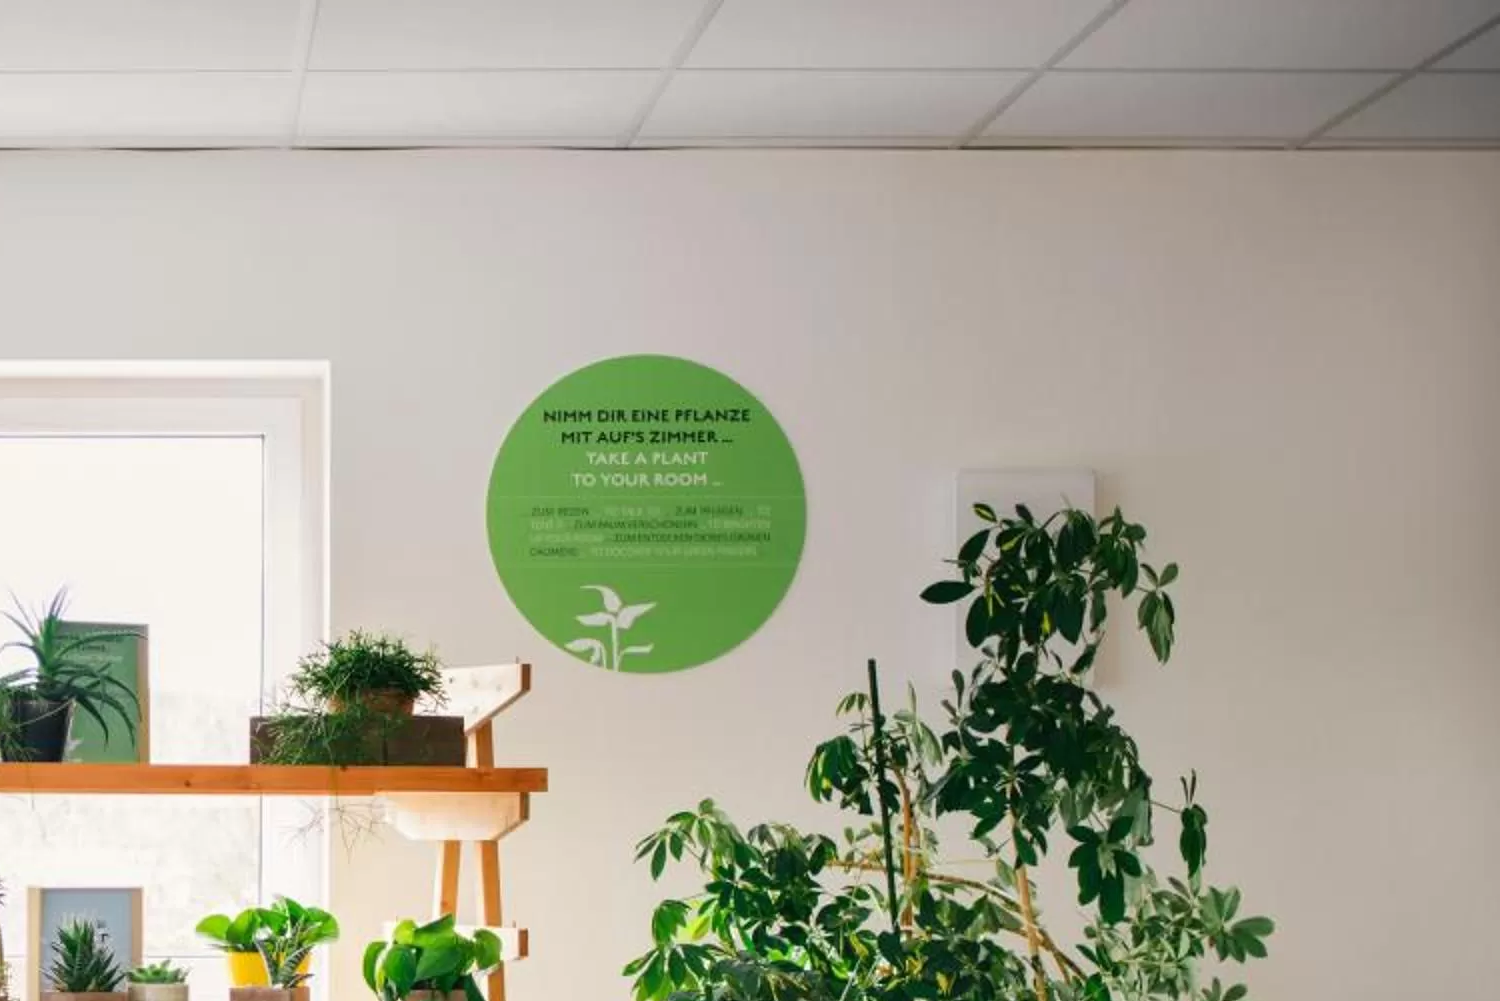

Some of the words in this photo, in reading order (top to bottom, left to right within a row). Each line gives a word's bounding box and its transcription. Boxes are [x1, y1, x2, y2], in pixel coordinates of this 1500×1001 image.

[543, 409, 592, 423] NIMM
[597, 409, 627, 423] DIR
[632, 409, 669, 423] EINE
[675, 409, 751, 423] PFLANZE
[561, 431, 592, 444] MIT
[596, 431, 645, 444] AUF'S
[649, 431, 718, 444] ZIMMER
[586, 451, 630, 465] TAKE
[634, 451, 648, 465] A
[652, 451, 708, 465] PLANT
[571, 473, 597, 488] TO
[600, 473, 650, 488] YOUR
[654, 473, 708, 487] ROOM
